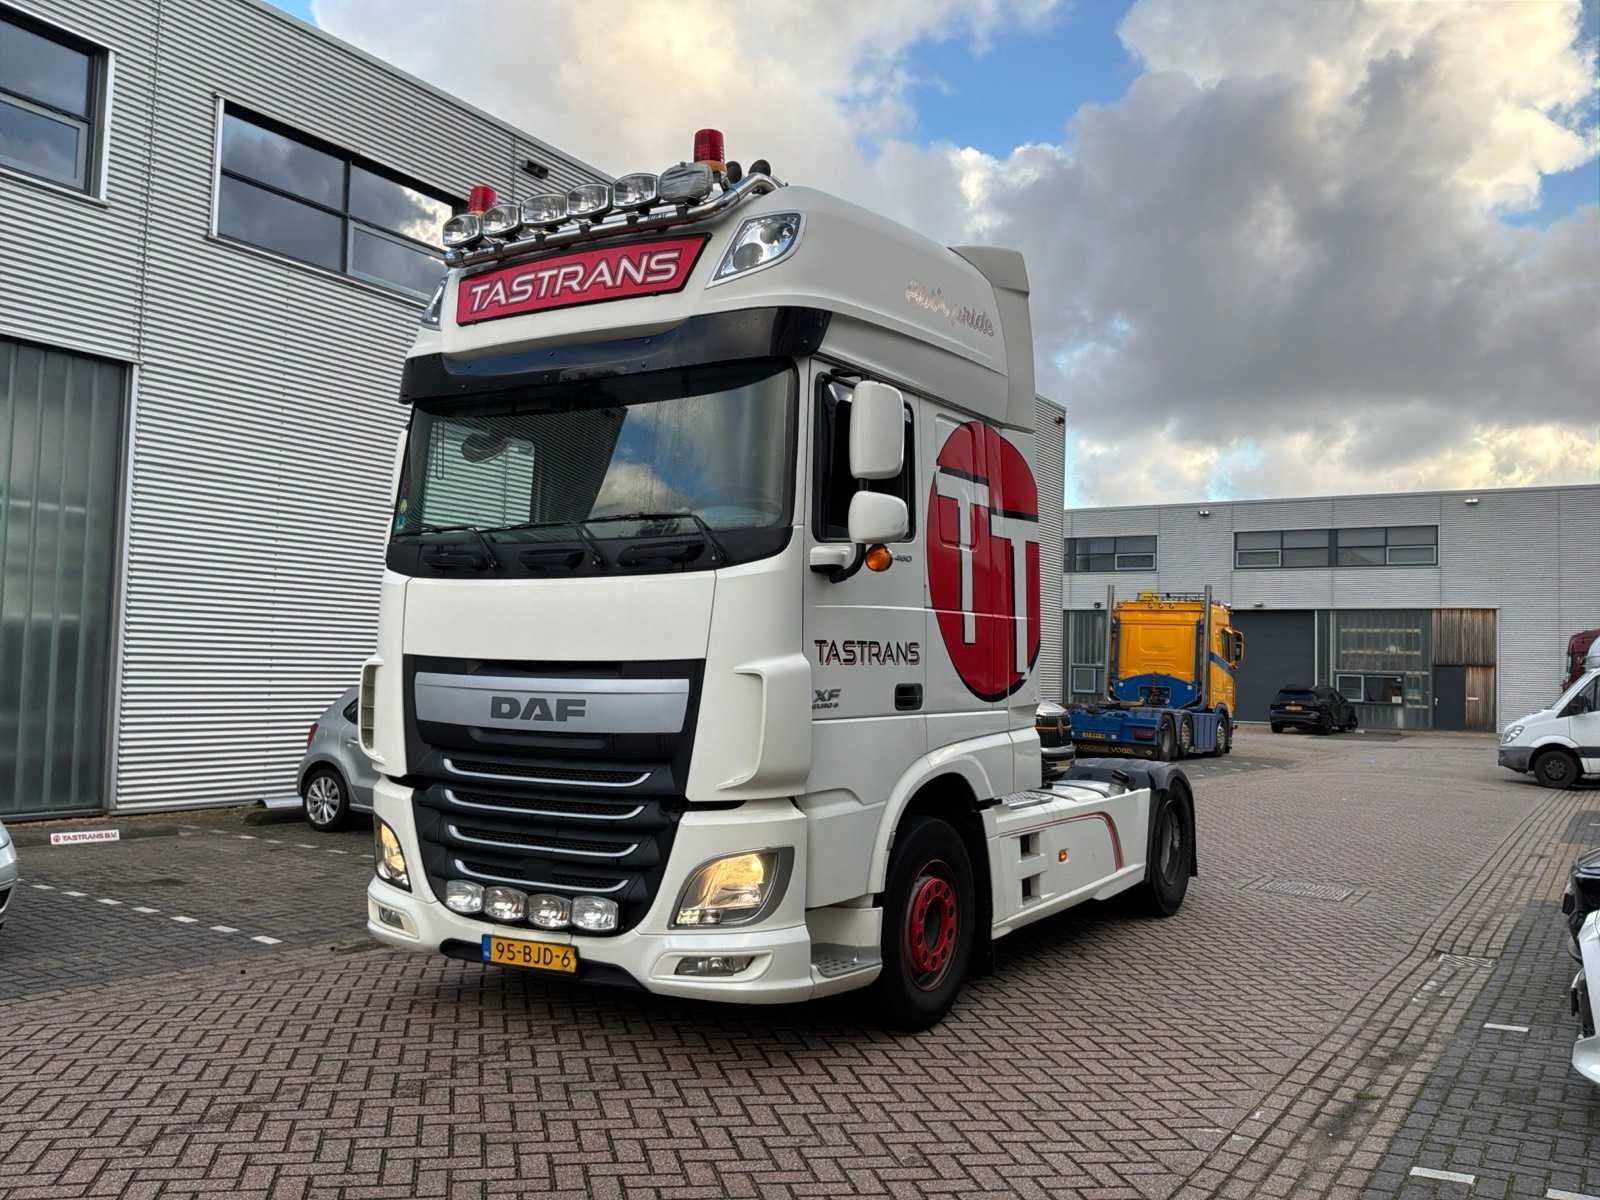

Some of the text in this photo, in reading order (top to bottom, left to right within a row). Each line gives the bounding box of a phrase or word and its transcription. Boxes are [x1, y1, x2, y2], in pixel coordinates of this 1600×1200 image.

[470, 249, 682, 312] TASTRANS
[814, 640, 920, 666] TASTRANS
[813, 688, 842, 702] XF
[490, 696, 586, 722] DAF
[495, 942, 571, 968] 95-BJD-6
